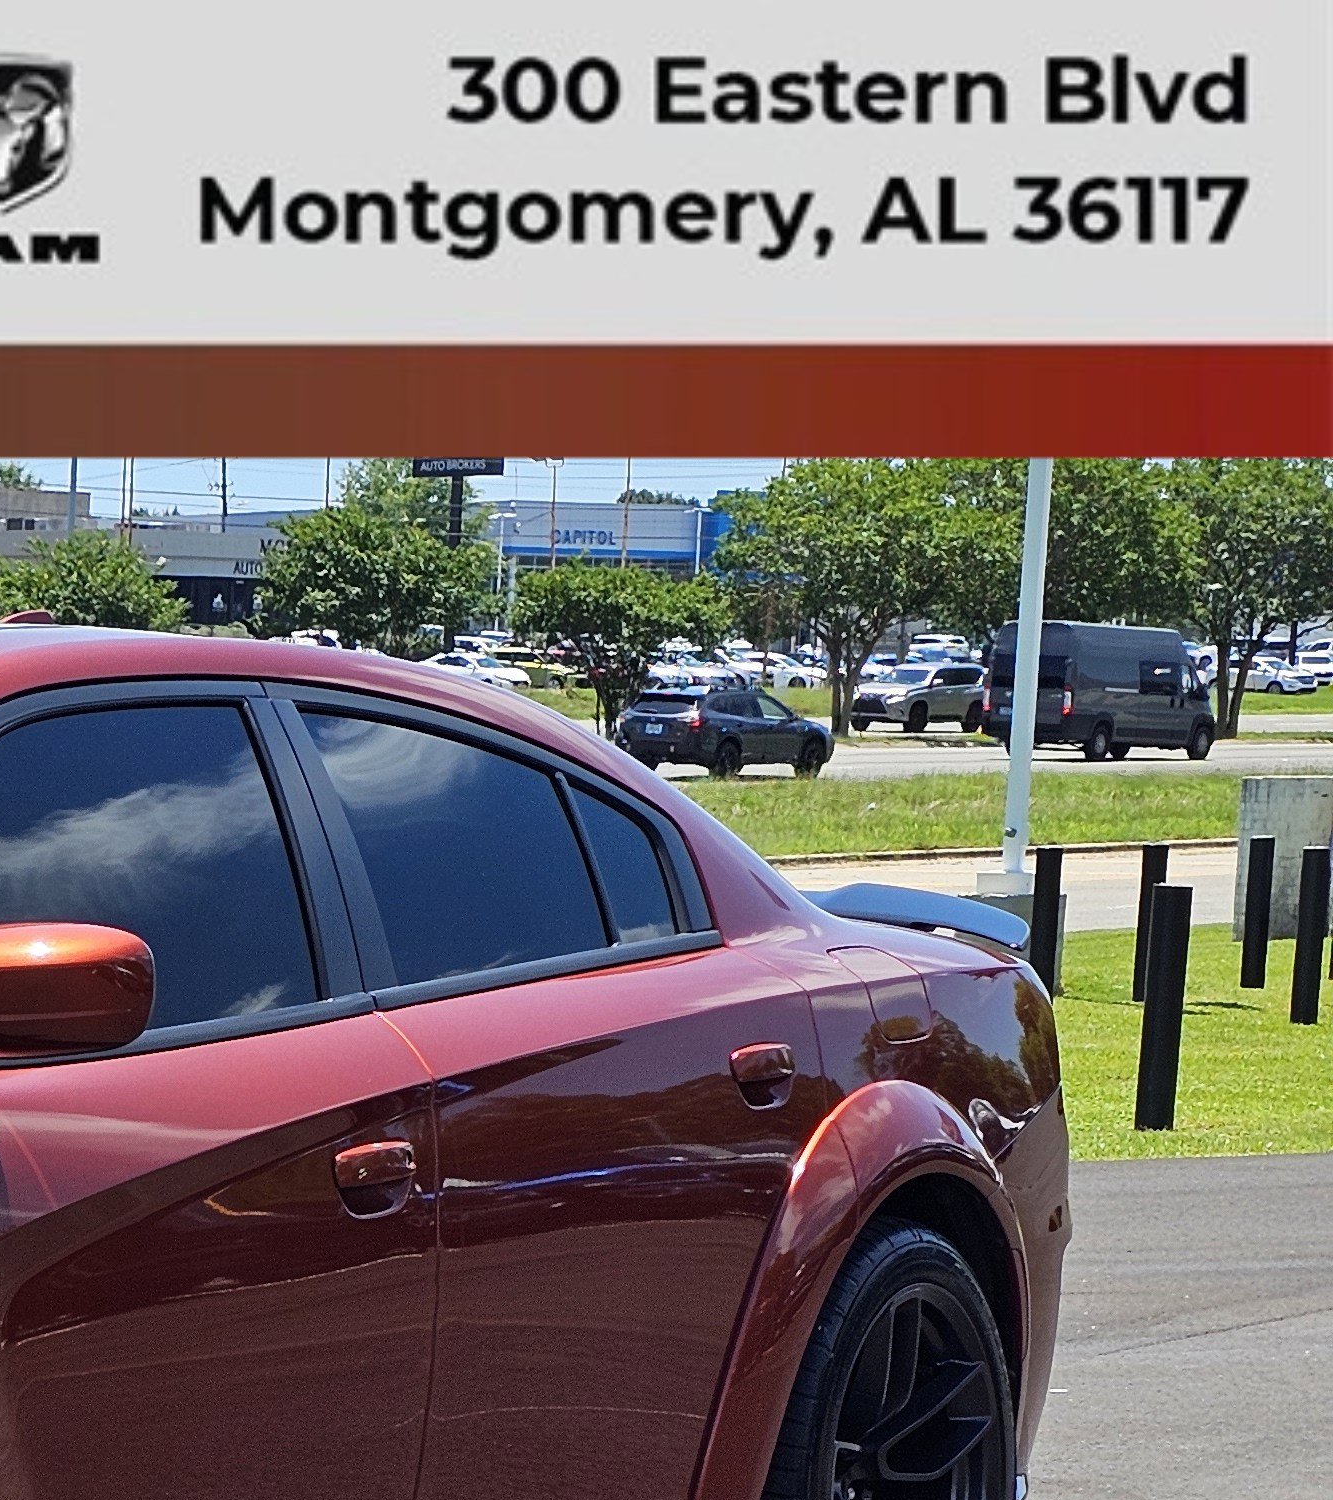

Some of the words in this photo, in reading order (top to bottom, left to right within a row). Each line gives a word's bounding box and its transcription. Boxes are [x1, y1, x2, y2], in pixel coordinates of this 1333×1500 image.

[419, 460, 446, 472] AUTO
[446, 458, 487, 471] BROKERS
[551, 528, 616, 546] CAPITOL
[233, 560, 263, 576] AUTO
